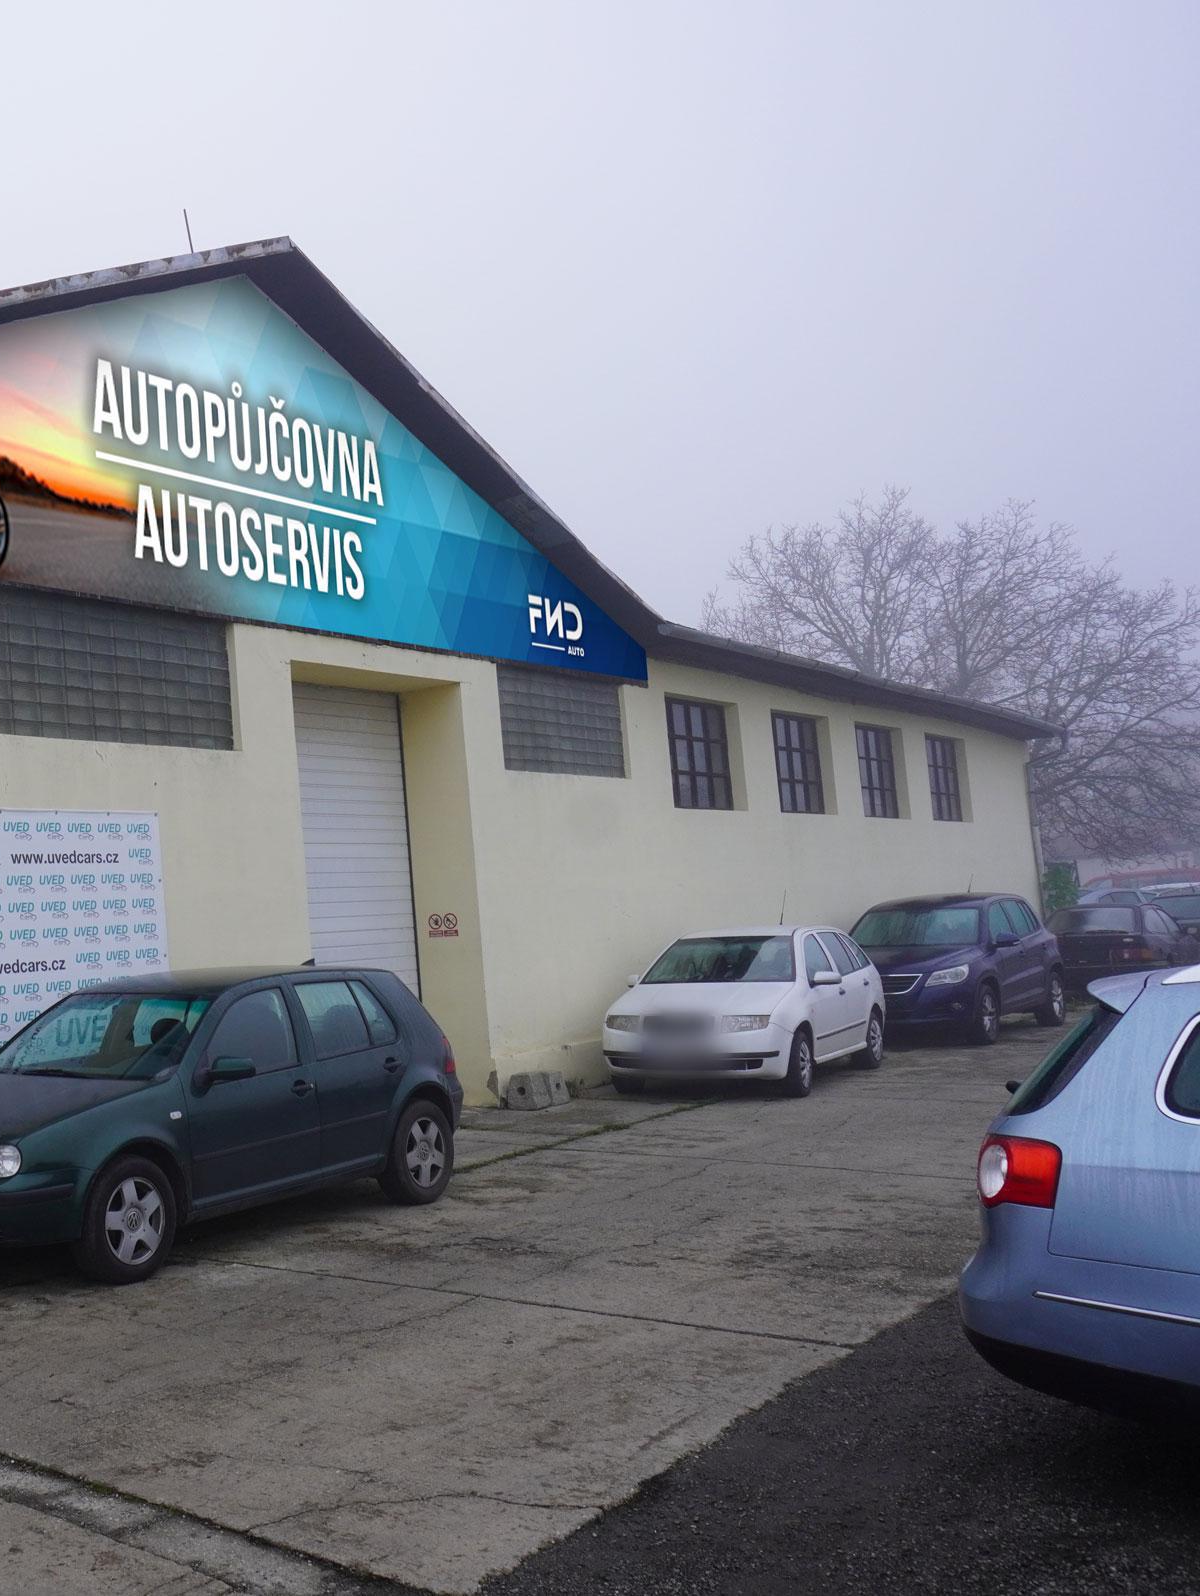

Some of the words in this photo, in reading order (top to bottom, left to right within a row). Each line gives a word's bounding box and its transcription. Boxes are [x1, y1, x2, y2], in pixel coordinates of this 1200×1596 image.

[93, 358, 384, 506] AUTOPŮJČOVNA
[134, 484, 366, 601] AUTOSERVIS
[567, 645, 585, 657] AUTO
[3, 821, 29, 831] UVED
[35, 822, 61, 831] UVED
[67, 822, 91, 832] UVED
[97, 823, 121, 833] UVED
[126, 824, 149, 833] UVED
[11, 849, 119, 865] www.uvedcars.cz
[128, 849, 151, 858] UVED
[6, 875, 32, 885] UVED
[38, 874, 64, 885] UVED
[70, 874, 94, 884] UVED
[100, 874, 124, 884] UVED
[130, 873, 152, 883] UVED
[7, 901, 34, 912] UVED
[40, 901, 65, 911] UVED
[72, 900, 96, 910] UVED
[102, 899, 126, 909] UVED
[131, 898, 154, 908] UVED
[9, 928, 35, 939] UVED
[42, 927, 67, 938] UVED
[73, 926, 98, 937] UVED
[104, 924, 127, 935] UVED
[133, 923, 156, 934] UVED
[75, 952, 99, 963] UVED
[105, 950, 129, 961] UVED
[134, 948, 157, 959] UVED
[12, 982, 38, 994] UVED
[45, 980, 70, 992] UVED
